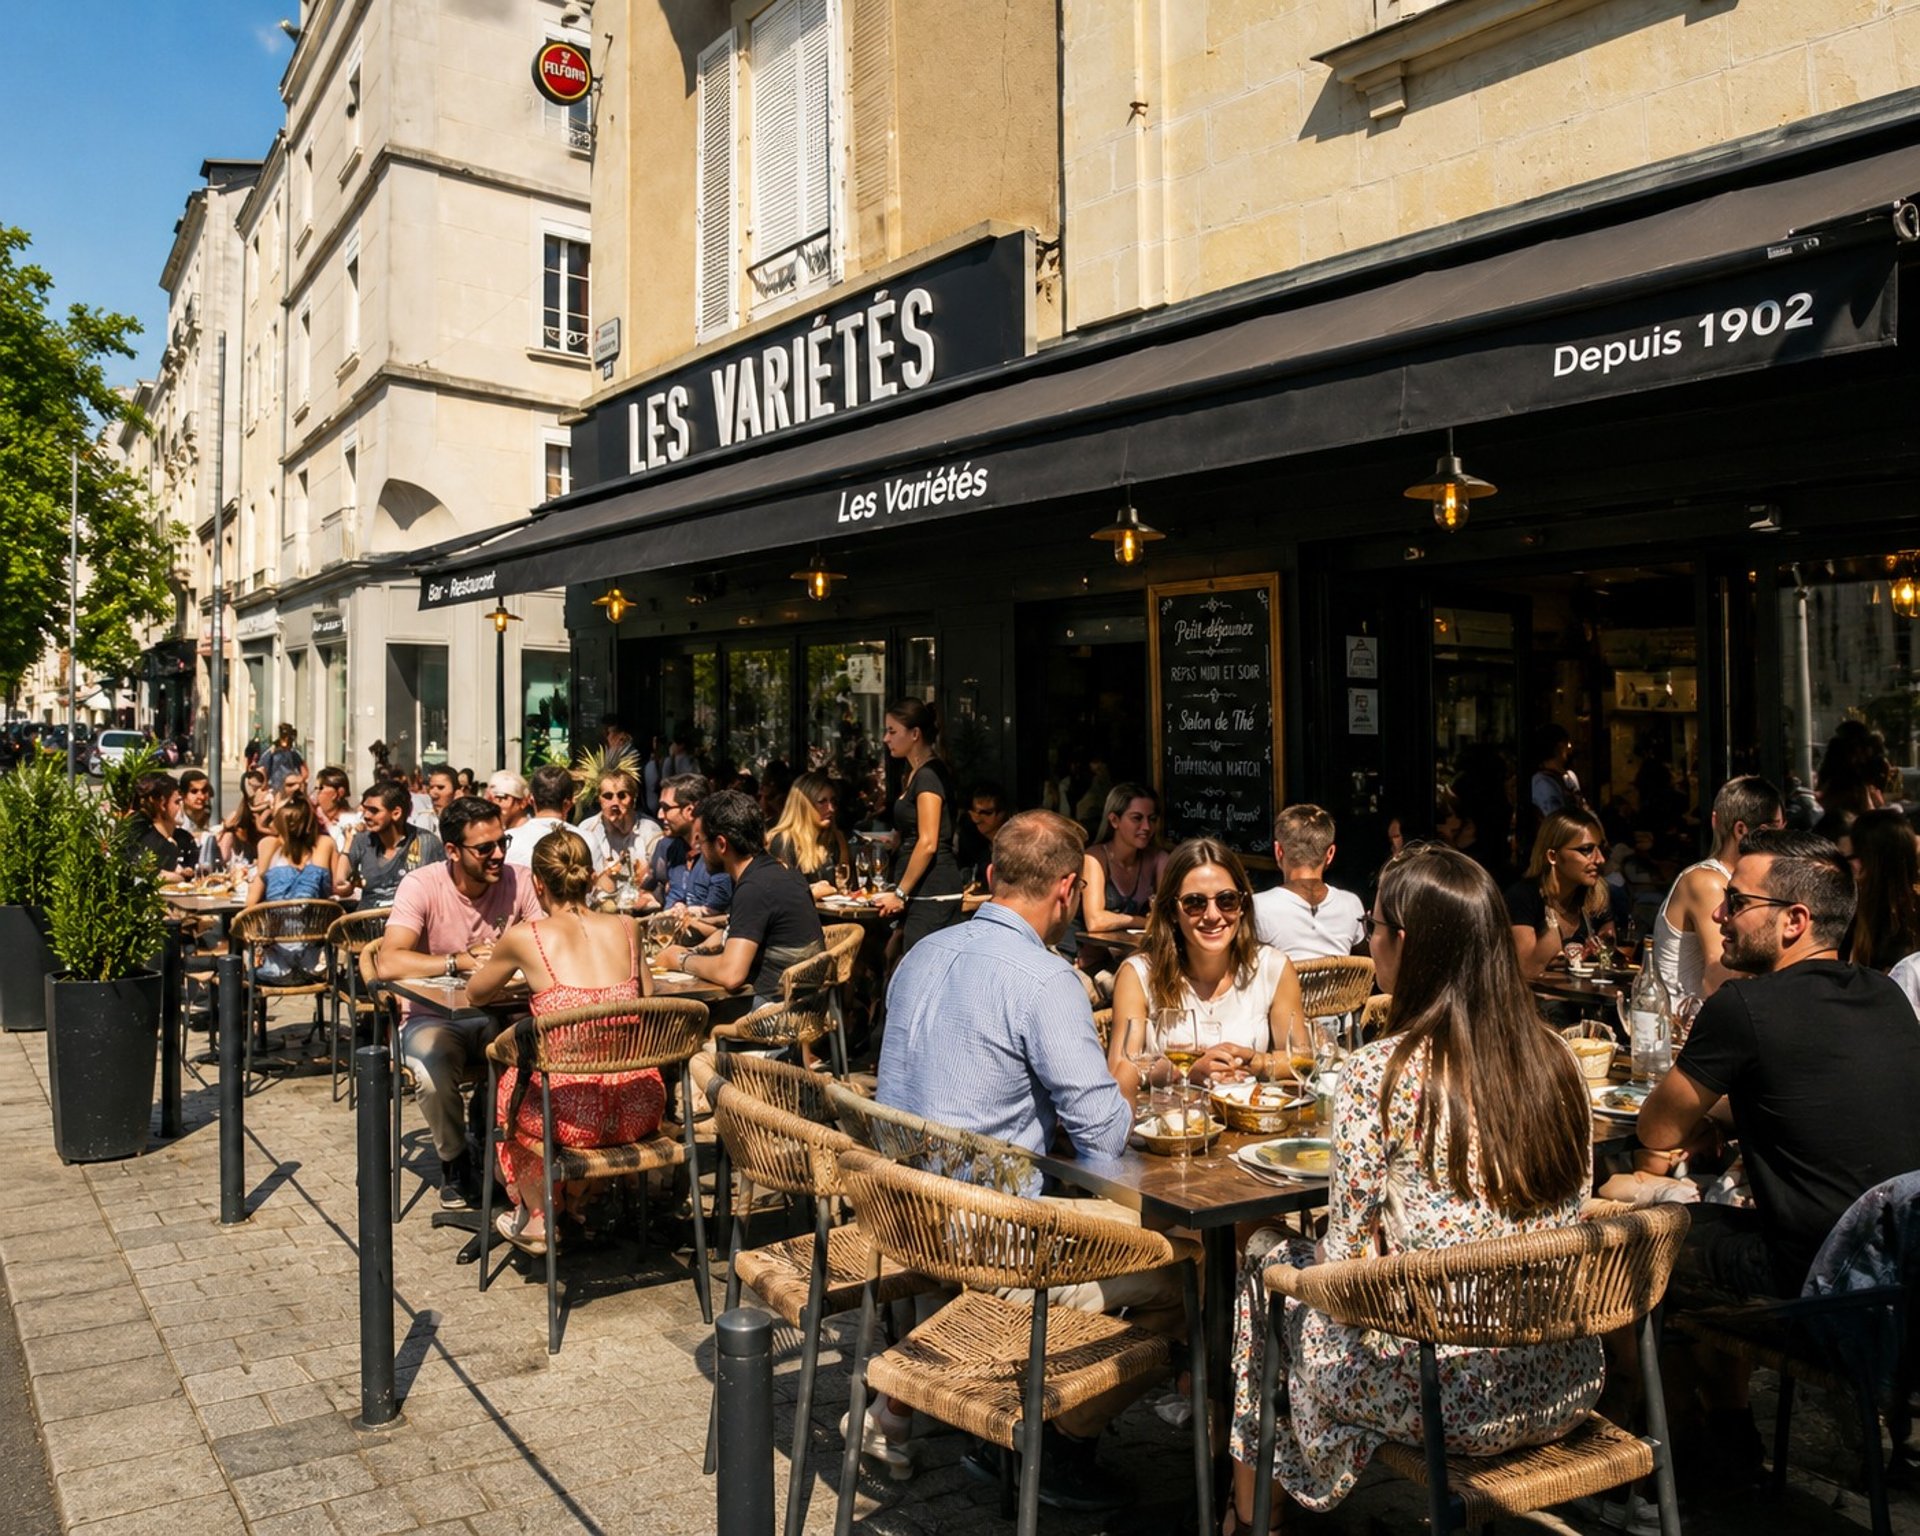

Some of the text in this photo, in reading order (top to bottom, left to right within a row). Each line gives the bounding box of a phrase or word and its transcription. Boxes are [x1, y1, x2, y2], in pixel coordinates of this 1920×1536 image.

[1553, 292, 1814, 377] Depuis 1902
[628, 288, 935, 475] LES VARIÉTÉS
[837, 461, 989, 524] Les Variétés
[1223, 665, 1235, 680] ET
[1179, 708, 1255, 731] Salon de Thé
